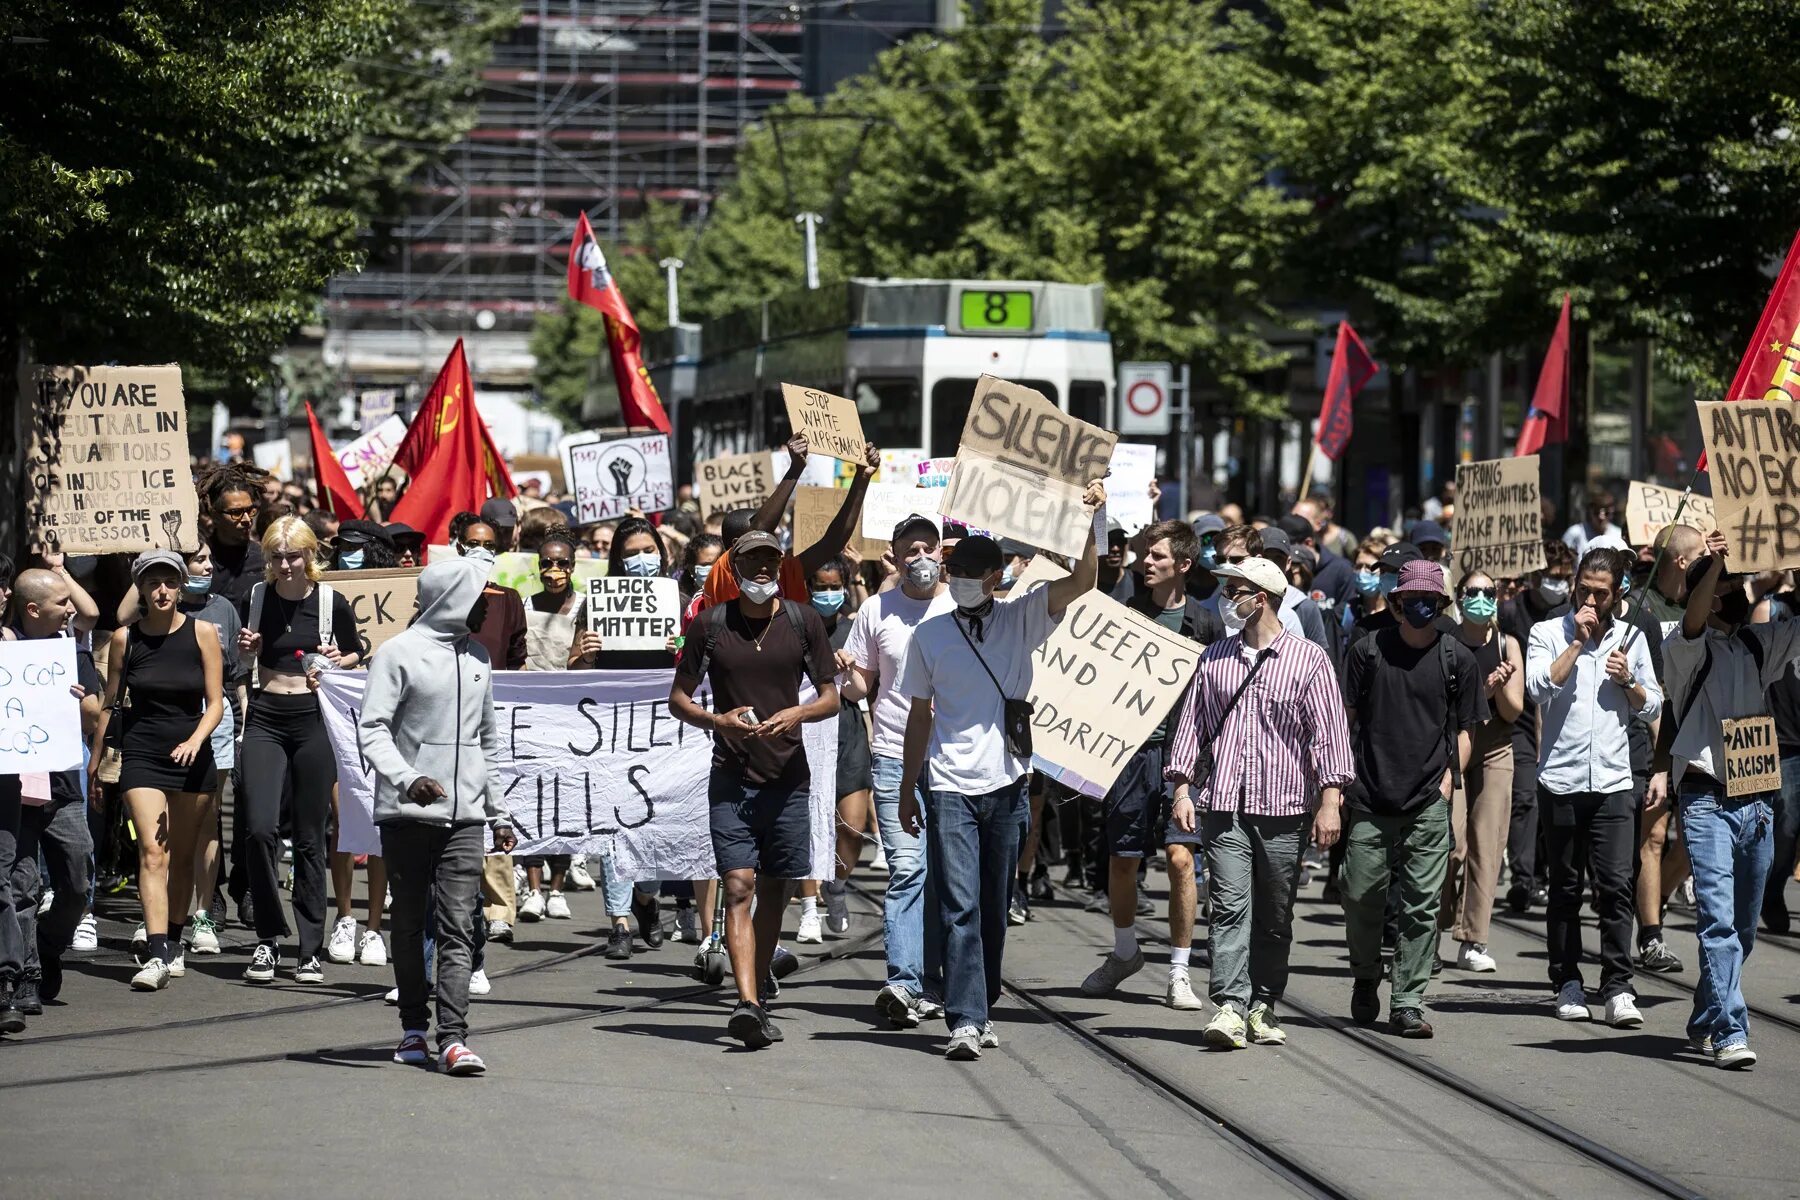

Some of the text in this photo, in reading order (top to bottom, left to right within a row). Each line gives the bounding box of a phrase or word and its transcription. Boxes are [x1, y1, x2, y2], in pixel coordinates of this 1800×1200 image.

[985, 291, 1008, 325] 8
[62, 380, 107, 409] YOU
[111, 383, 157, 407] ARE
[804, 390, 830, 411] STOP
[42, 411, 178, 440] NEUTRAL IN
[799, 409, 841, 432] WHITE
[800, 427, 863, 461] SUPREMACY
[971, 392, 1112, 485] SILENCE
[35, 469, 175, 491] OF INJUSTICE
[704, 461, 763, 481] BLACK
[918, 461, 931, 475] IF
[1456, 461, 1502, 489] STRONG
[1716, 452, 1800, 499] NO EX
[46, 491, 173, 511] OU HAVE CHOSEN
[711, 479, 766, 497] LIVES
[1463, 483, 1537, 511] COMMUNITIES
[33, 509, 151, 526] THE SIDE OF THE
[950, 462, 1093, 549] VIOLENCE
[45, 523, 150, 543] OPPRESSOR!
[1456, 512, 1538, 541] MAKE POLICE
[590, 579, 654, 594] BLACK
[351, 591, 395, 624] CK
[592, 595, 658, 613] LIVES
[593, 617, 676, 637] MATTER
[23, 661, 66, 686] COP
[1036, 637, 1155, 716] AND IN
[6, 697, 24, 719] A
[567, 690, 714, 757] SILE
[1732, 724, 1771, 750] ANTI
[1727, 754, 1776, 780] RACISM
[505, 764, 655, 840] KILLS
